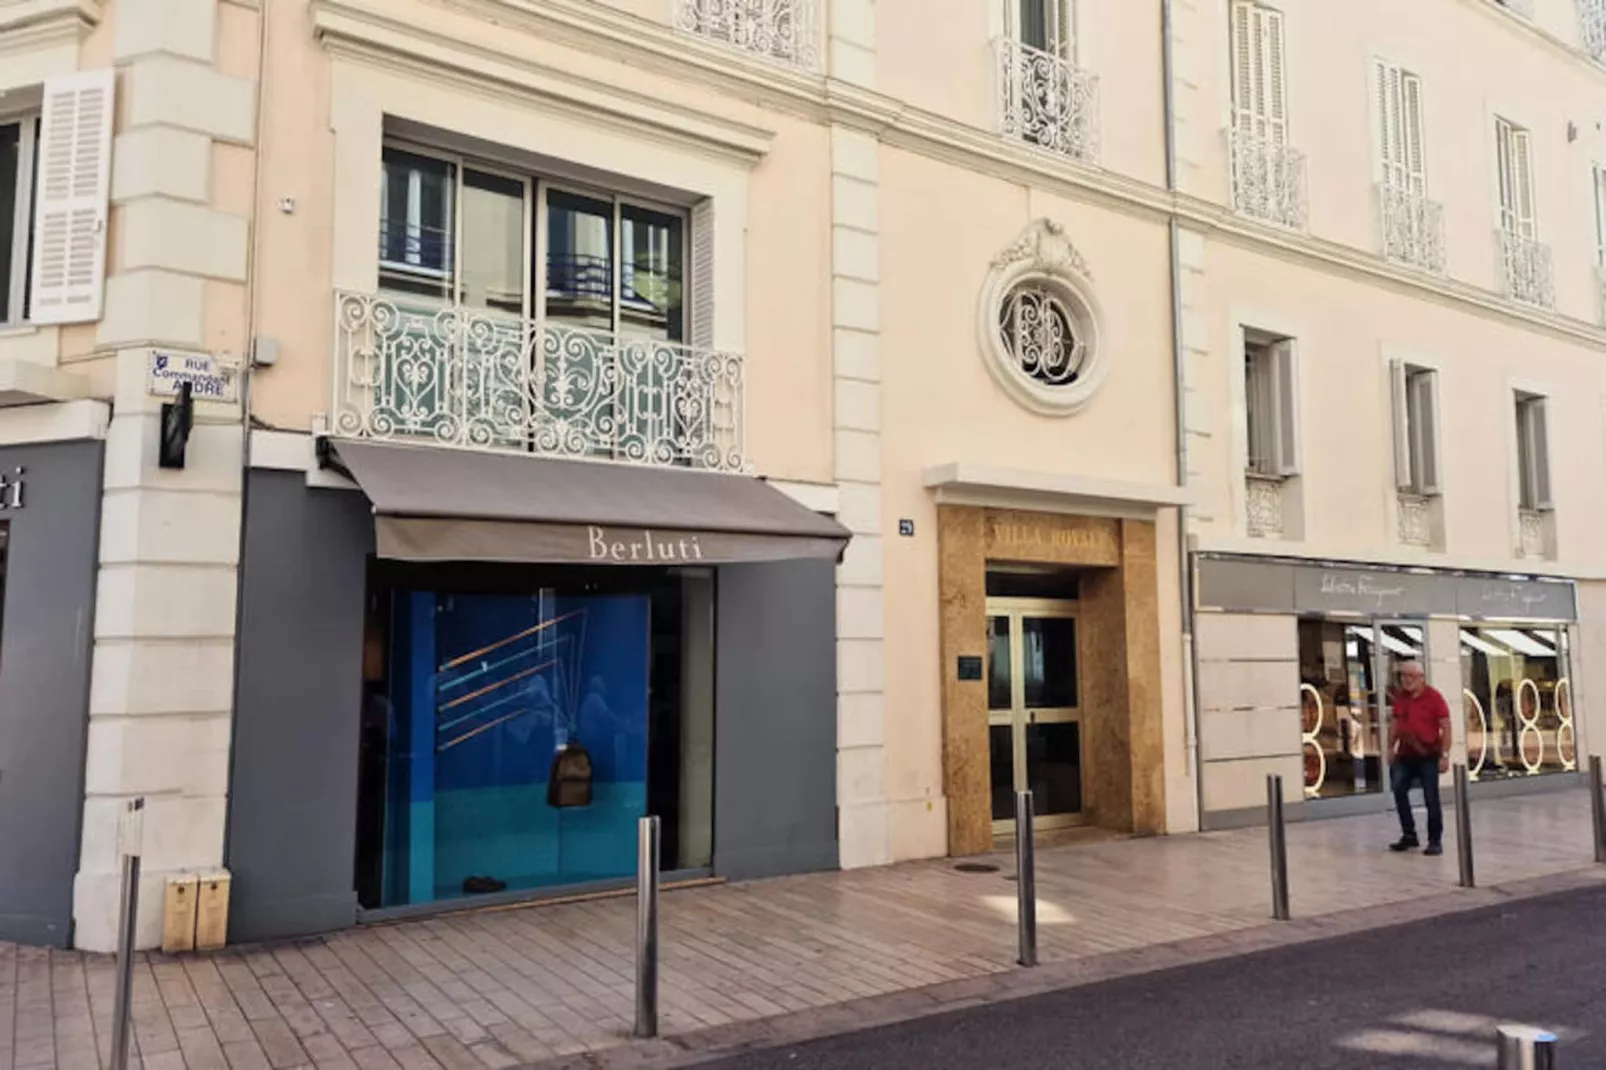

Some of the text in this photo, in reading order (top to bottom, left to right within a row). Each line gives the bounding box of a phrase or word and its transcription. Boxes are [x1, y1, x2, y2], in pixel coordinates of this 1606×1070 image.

[185, 358, 209, 372] RUE
[588, 525, 702, 560] Berluti
[994, 523, 1042, 546] VILLA
